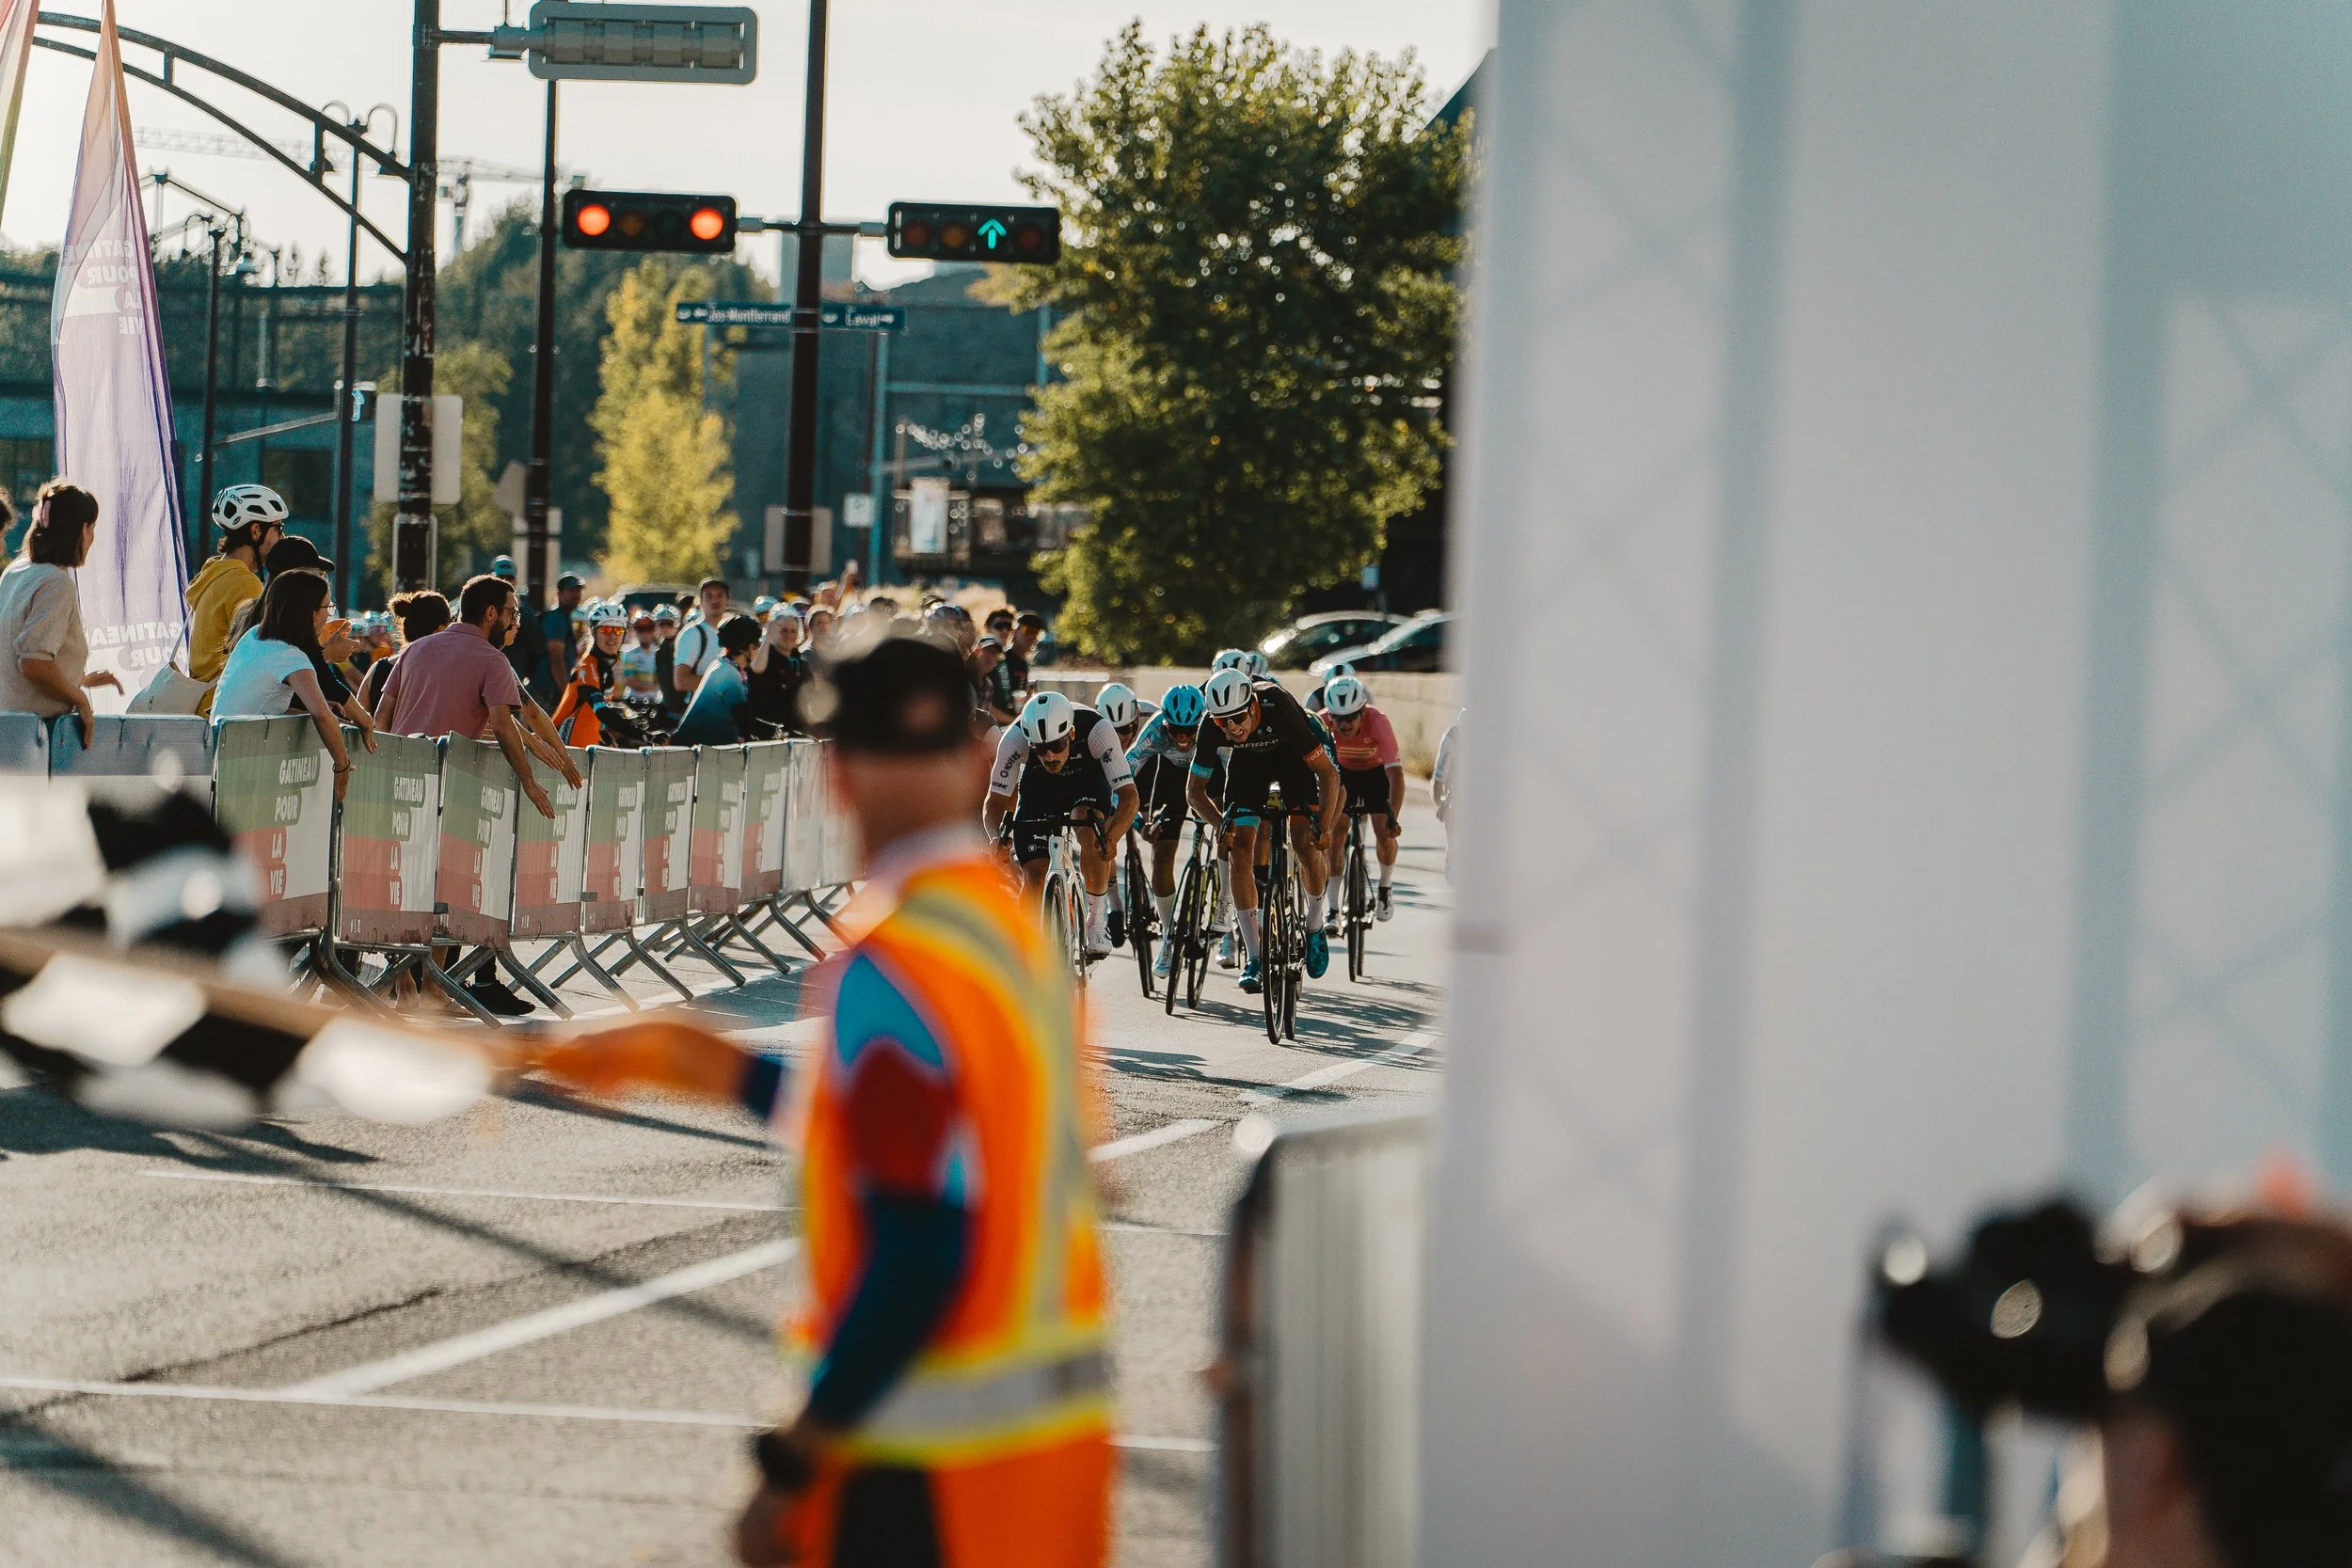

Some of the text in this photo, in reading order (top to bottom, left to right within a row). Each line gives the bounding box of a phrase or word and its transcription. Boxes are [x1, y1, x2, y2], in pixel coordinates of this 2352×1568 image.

[279, 755, 318, 784] GATINEAU
[393, 776, 423, 802] GATINEAU
[480, 784, 503, 815] GATINEAU
[275, 795, 298, 822] POUR
[392, 811, 408, 836] POUR
[476, 817, 490, 844] POUR
[553, 815, 565, 836] POUR
[271, 832, 282, 859] LA
[390, 846, 399, 870] LA
[270, 869, 283, 895] VIE
[389, 880, 400, 905] VIE
[472, 884, 481, 908] VIE
